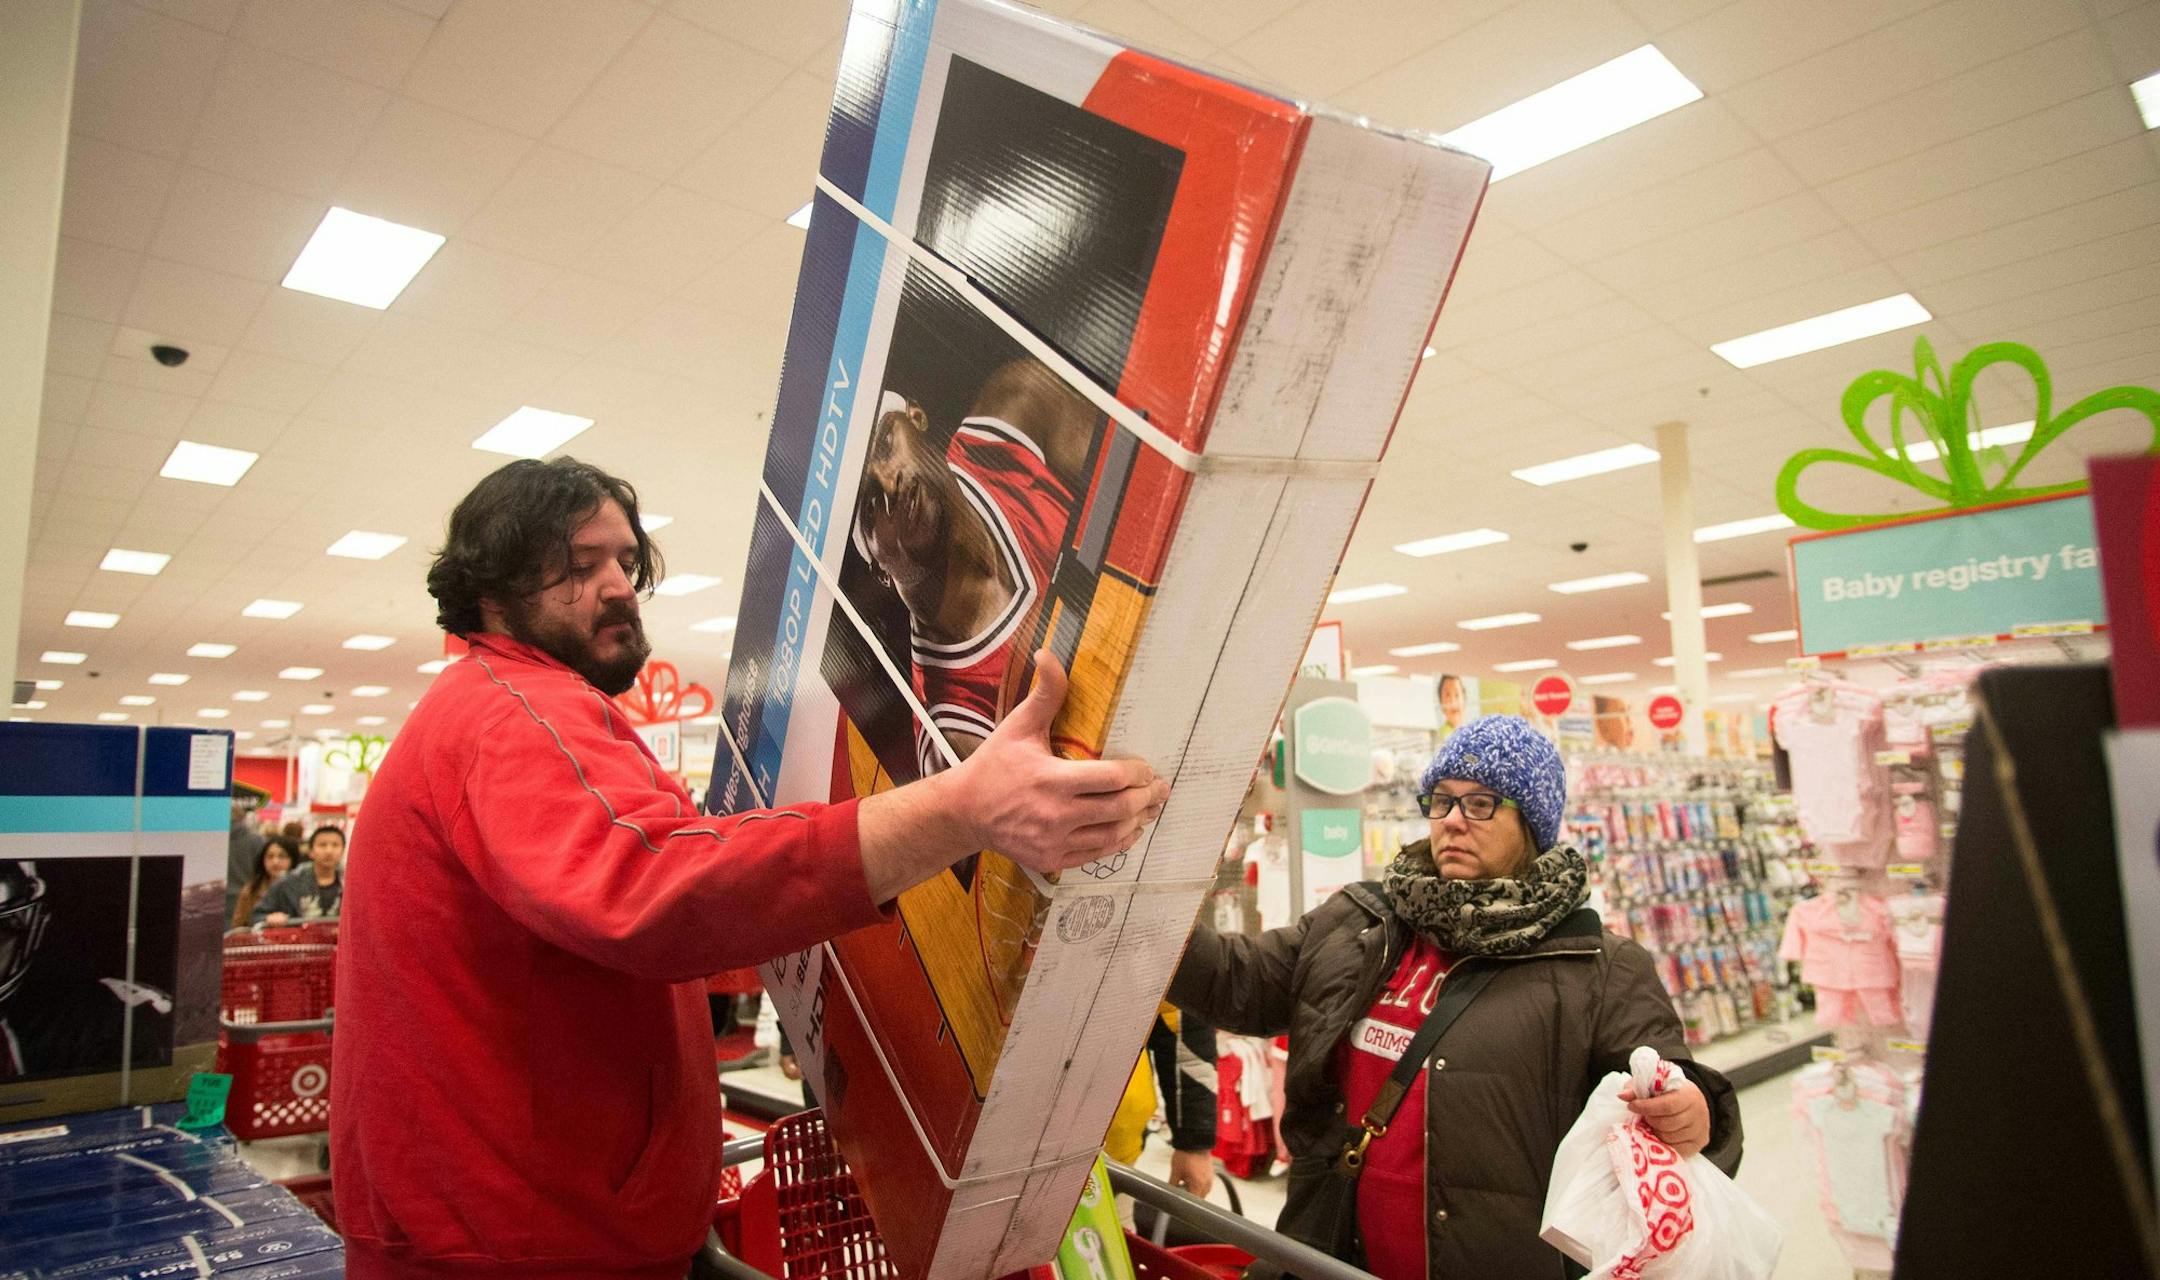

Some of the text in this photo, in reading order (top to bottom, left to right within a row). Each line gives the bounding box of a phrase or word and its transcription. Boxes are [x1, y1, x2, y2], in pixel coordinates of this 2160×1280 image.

[774, 358, 850, 706] 1080P LED HDTV
[1823, 544, 2098, 601] Baby registry fa
[723, 657, 759, 814] Westnghouse
[1364, 1026, 1410, 1053] CRIMS
[140, 1262, 198, 1279] NCH
